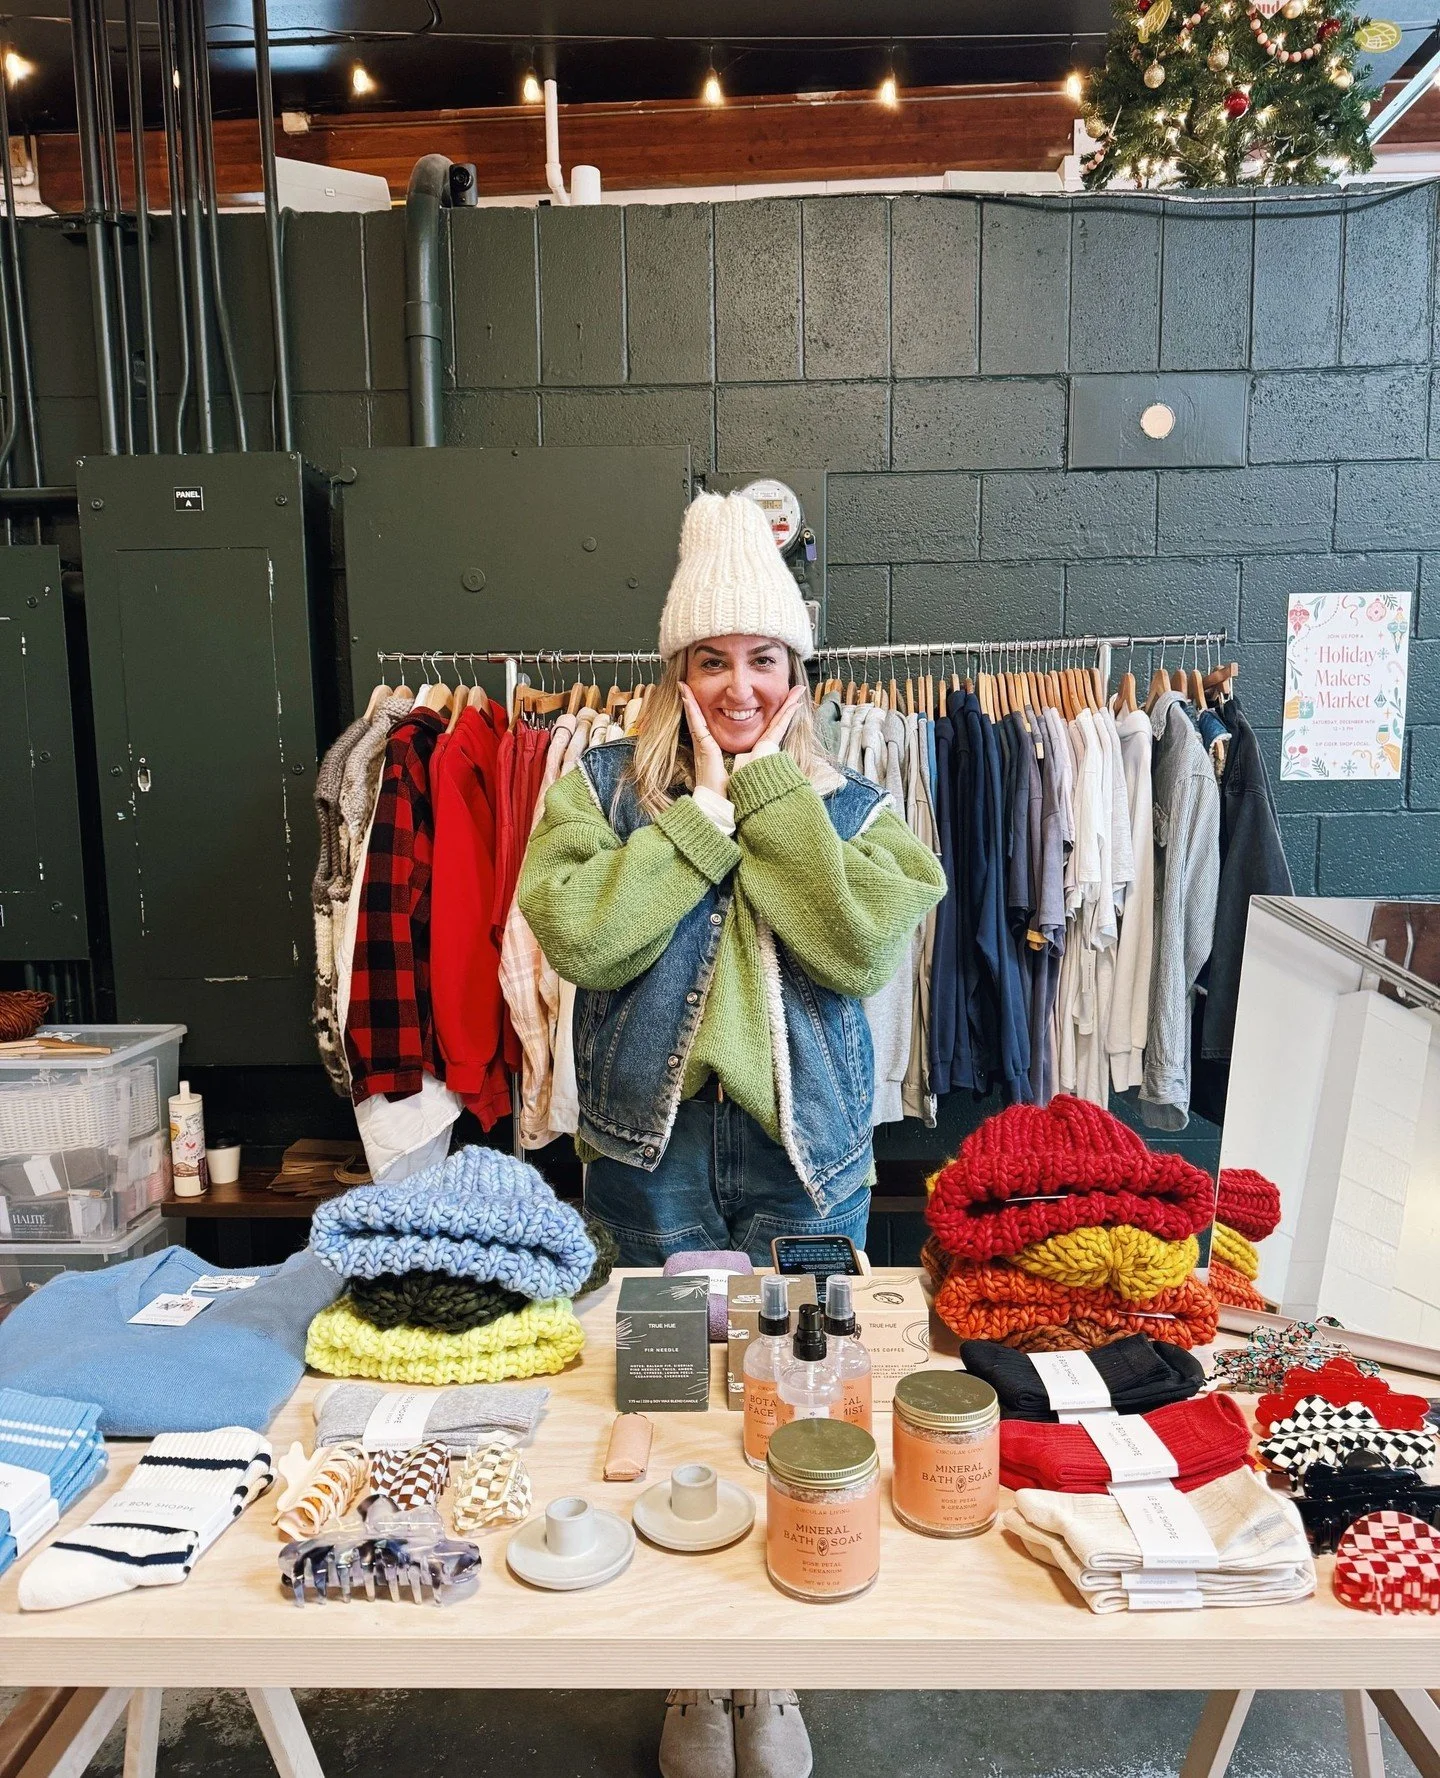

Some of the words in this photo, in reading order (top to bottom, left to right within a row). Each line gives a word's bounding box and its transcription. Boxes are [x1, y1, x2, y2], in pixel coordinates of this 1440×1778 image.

[185, 499, 192, 507] A
[1319, 645, 1376, 667] Holiday
[1315, 669, 1371, 687] Makers
[1316, 691, 1370, 708] Market
[1064, 1368, 1080, 1385] SHOPPE
[749, 1403, 774, 1417] FACE
[1123, 1437, 1143, 1456] SHOPPE
[922, 1472, 953, 1484] BATH
[967, 1468, 993, 1483] SOAK
[935, 1462, 984, 1474] MINERAL
[154, 1503, 197, 1512] SHOPPE
[795, 1506, 827, 1515] CIRCULAR
[795, 1523, 850, 1535] MINERAL
[1159, 1516, 1179, 1540] SHOPPE
[783, 1530, 814, 1546] BATH
[830, 1532, 862, 1547] SOAK
